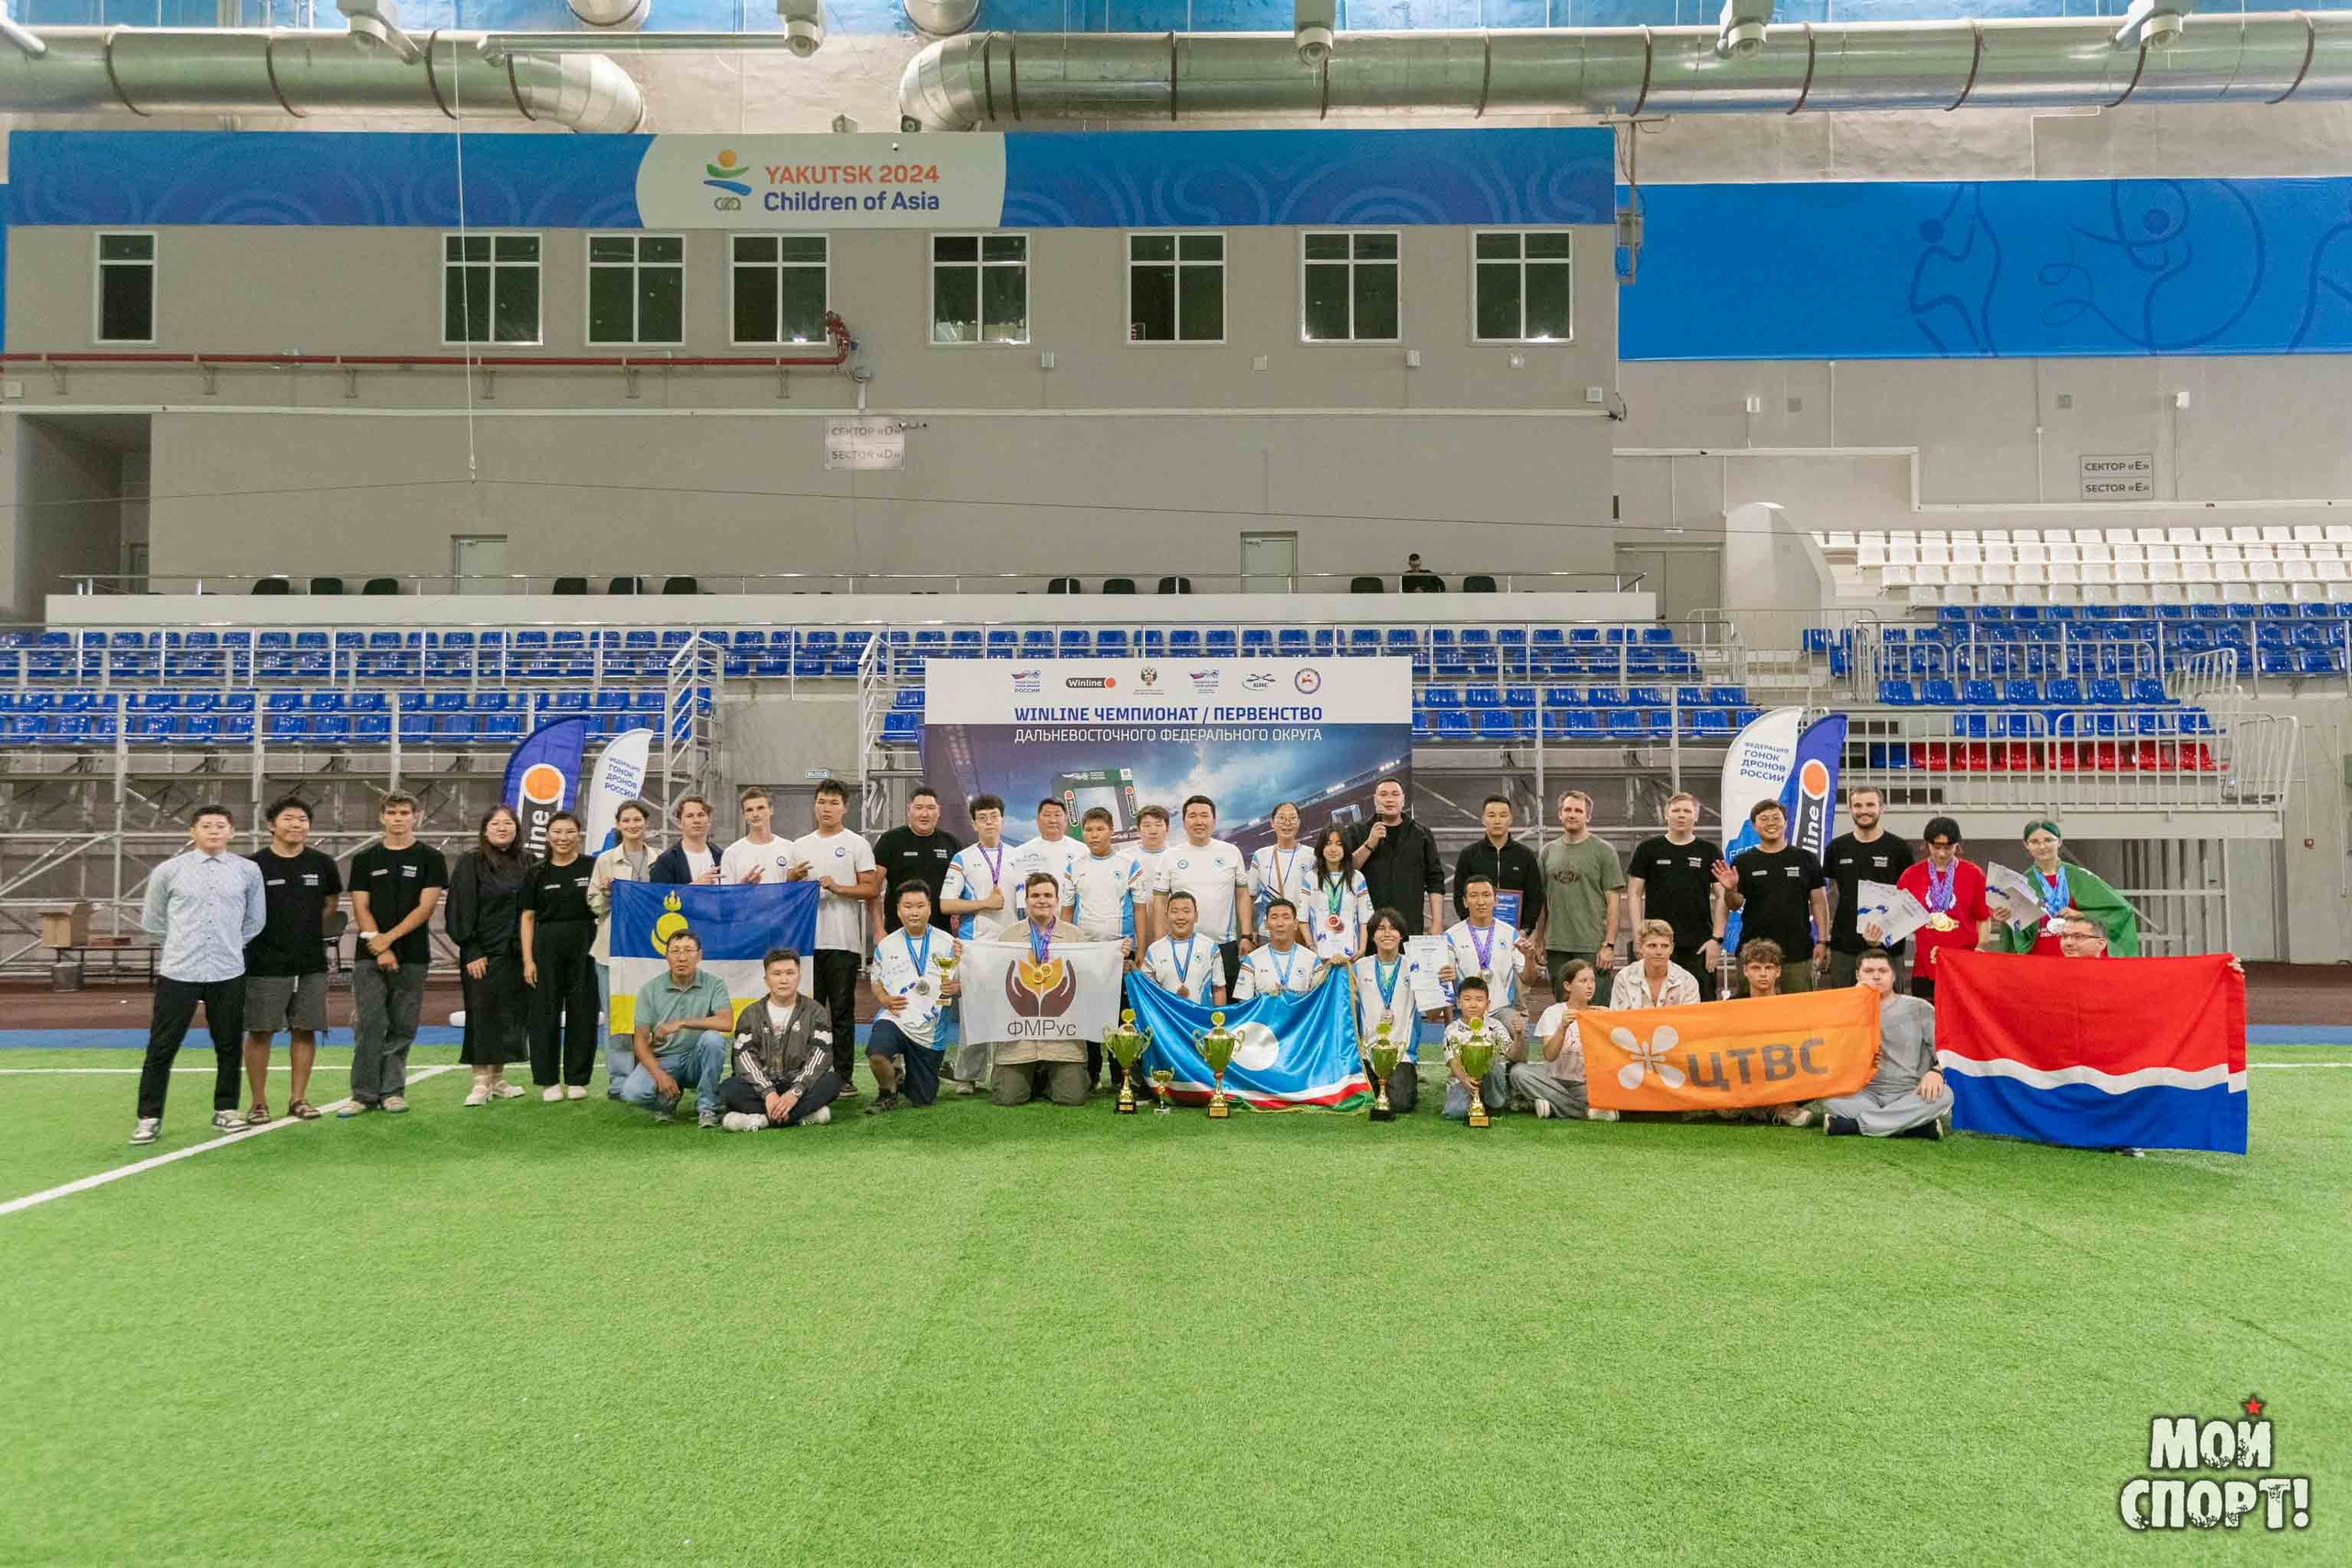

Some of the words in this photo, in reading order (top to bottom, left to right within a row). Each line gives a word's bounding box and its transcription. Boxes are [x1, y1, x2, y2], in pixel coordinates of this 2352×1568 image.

[765, 164, 873, 184] YAKUTSK
[878, 164, 940, 184] 2024
[763, 191, 857, 211] Children
[863, 191, 888, 210] of
[891, 191, 940, 210] Asia
[831, 427, 875, 435] СЕКТОР
[2085, 462, 2126, 471] СЕКТОР
[2085, 484, 2126, 492] SECTOR
[1069, 679, 1102, 687] Winline
[1014, 707, 1090, 721] WINLINE
[1094, 707, 1198, 721] ЧЕМПИОНАТ
[1214, 707, 1322, 721] ПЕРВЕНСТВО
[1014, 728, 1156, 744] ДАЛЬНЕВОСТОЧНОГО
[1159, 728, 1268, 743] ФЕДЕРАЛЬНОГО
[1272, 728, 1322, 741] ОКРУГА
[1745, 741, 1789, 753] ФЕДЕРАЦИЯ
[1745, 750, 1781, 761] ГОНОК
[608, 764, 634, 777] ГОНОК
[1741, 759, 1786, 773] ДРОНОВ
[606, 773, 638, 789] ДРОНОВ
[1739, 768, 1785, 783] РОССИИ
[605, 783, 636, 798] РОССИИ
[1007, 1019, 1077, 1036] ФМРус
[1686, 1037, 1827, 1091] ЦТВС
